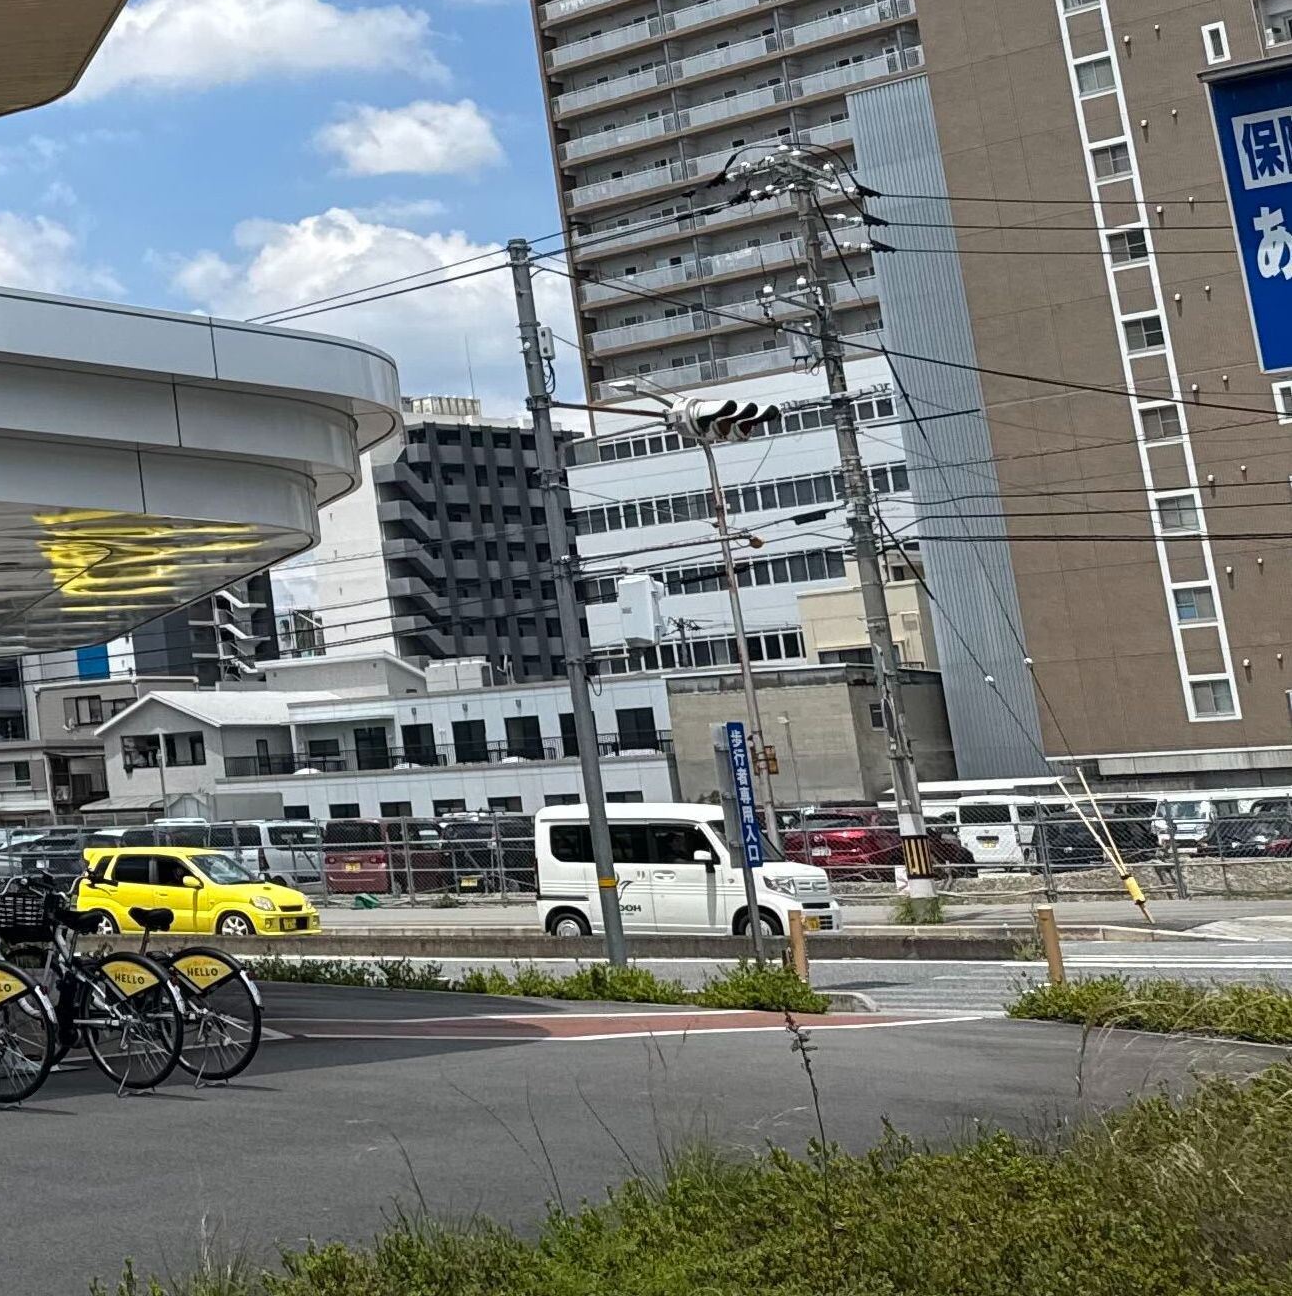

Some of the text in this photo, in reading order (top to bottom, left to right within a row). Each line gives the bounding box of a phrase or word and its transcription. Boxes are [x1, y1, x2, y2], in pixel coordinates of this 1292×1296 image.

[1242, 121, 1292, 182] 保
[1253, 206, 1292, 281] あ
[730, 729, 760, 862] 歩行者専用入口
[114, 972, 146, 986] HELLO
[186, 966, 219, 978] HELLO
